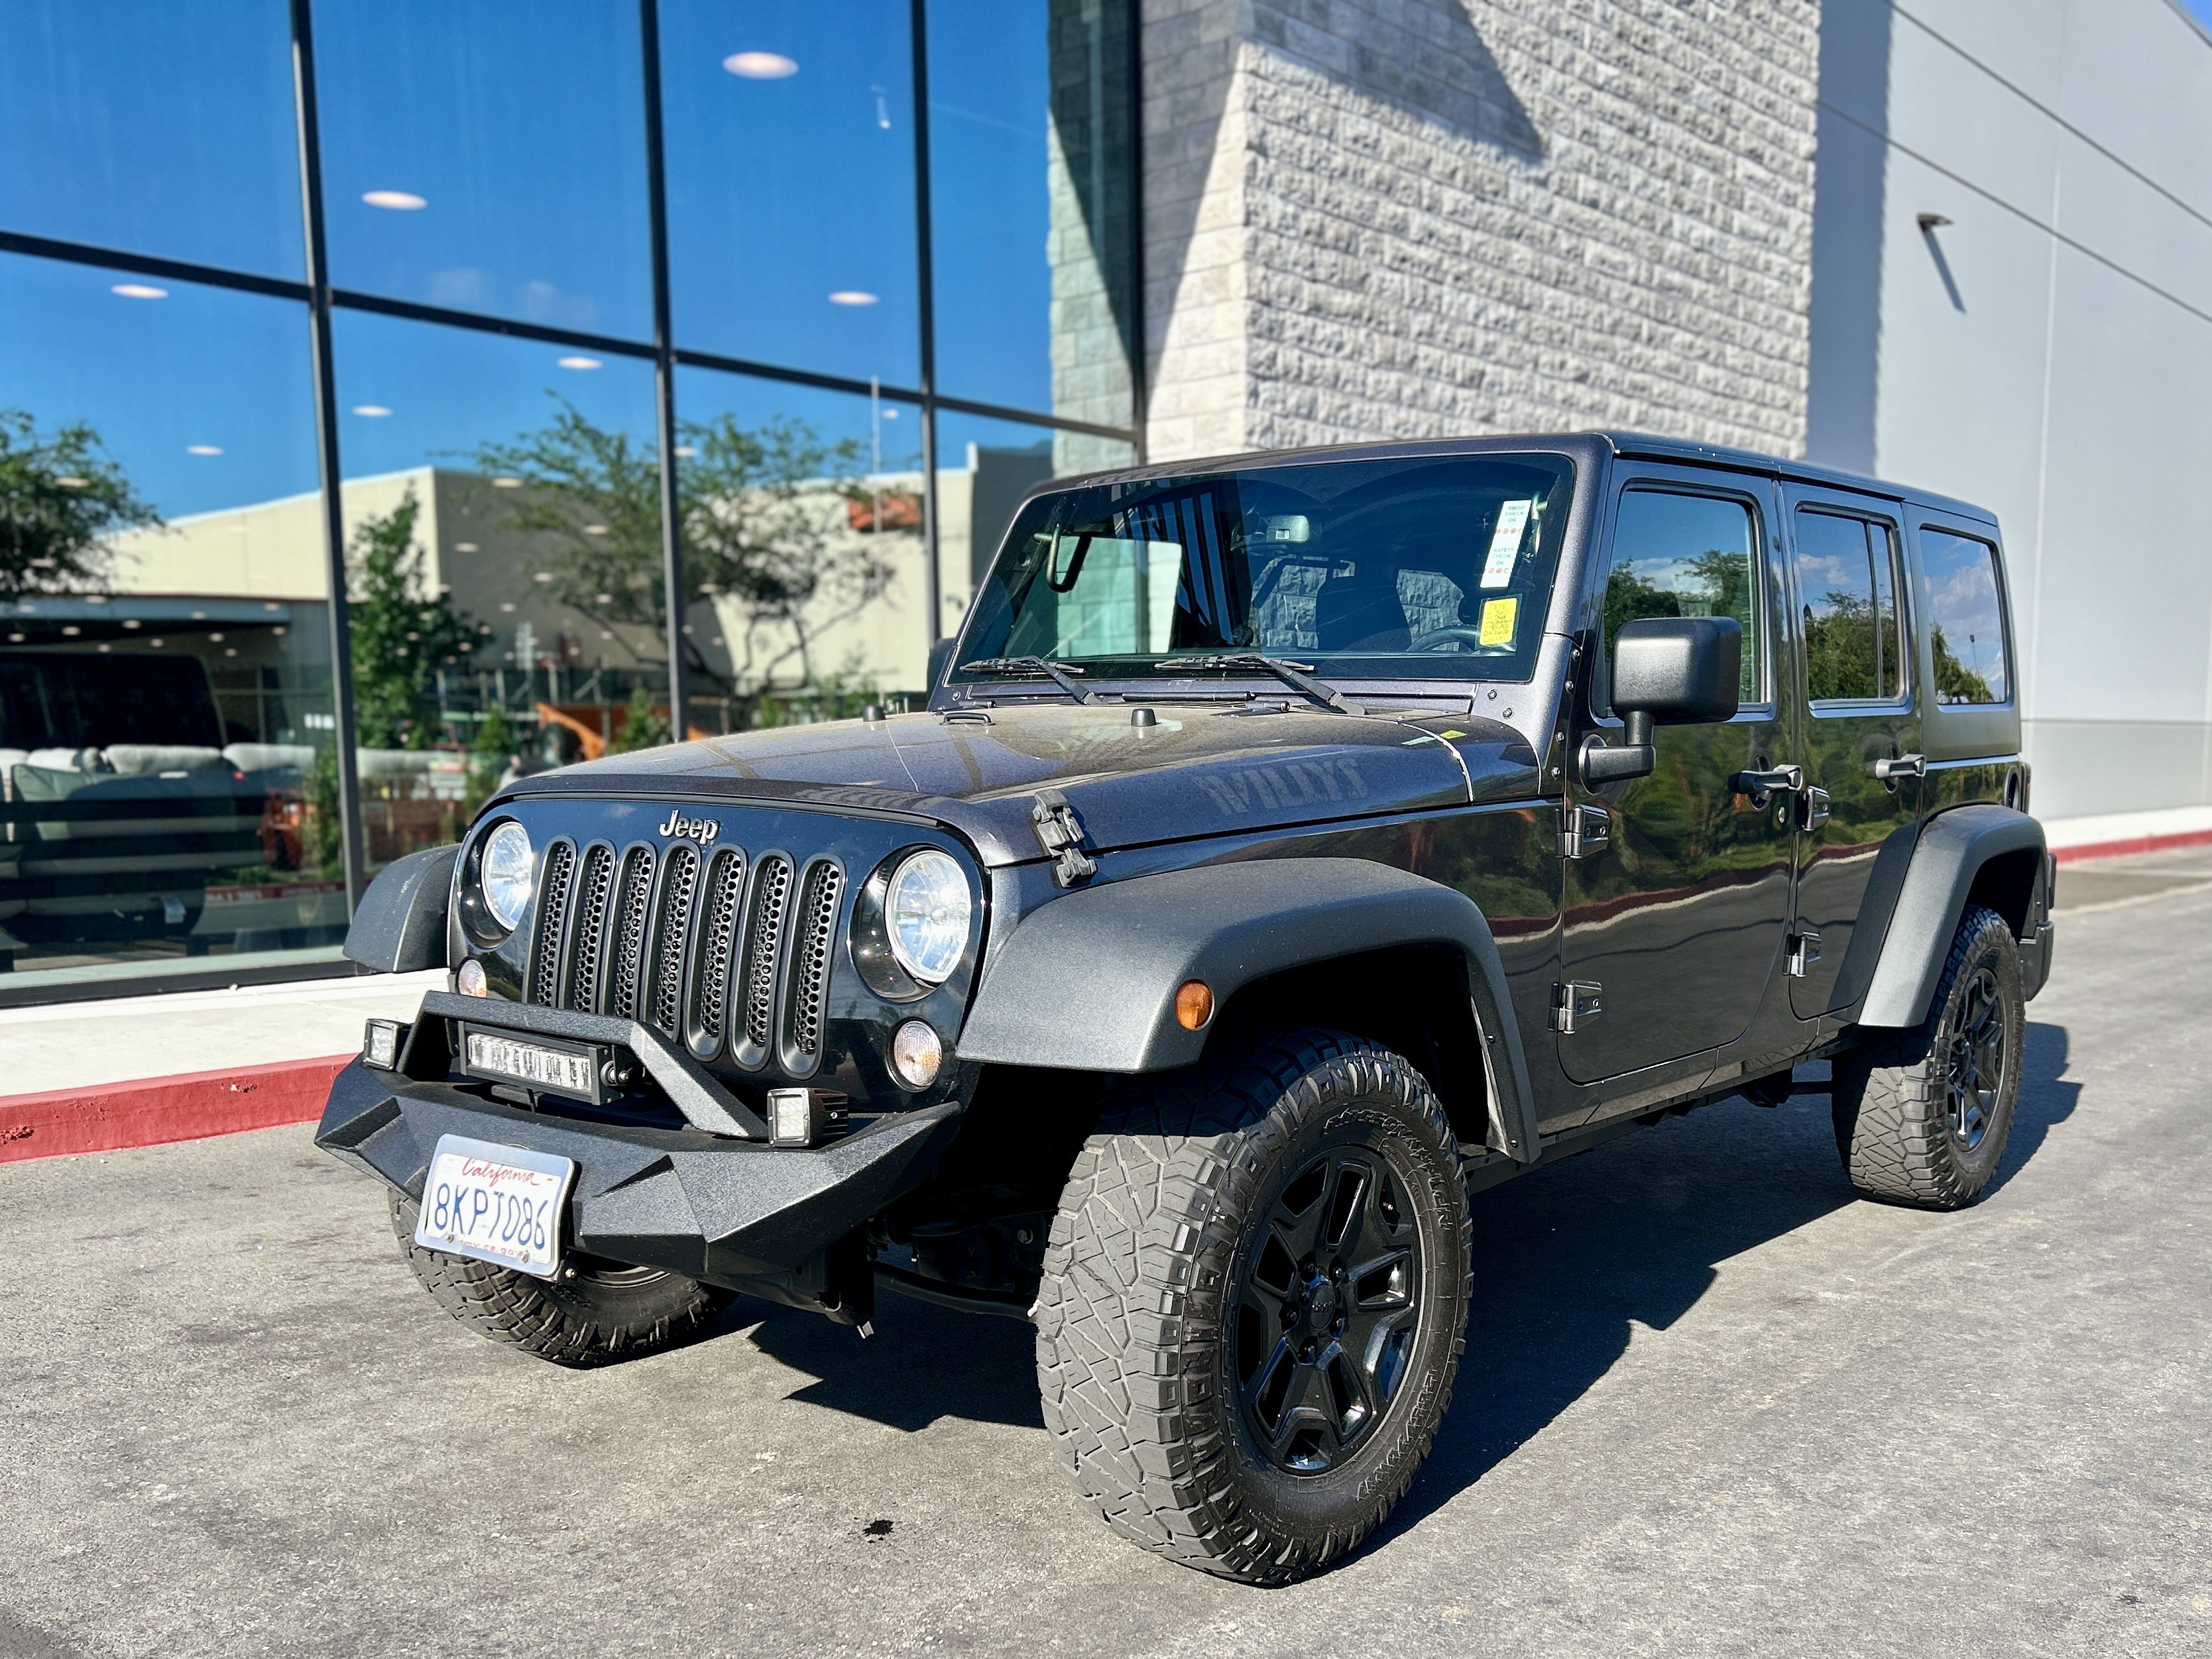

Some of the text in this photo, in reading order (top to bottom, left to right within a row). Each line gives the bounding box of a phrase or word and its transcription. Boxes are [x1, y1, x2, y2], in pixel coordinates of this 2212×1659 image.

[1194, 758, 1368, 817] WILLYS
[658, 809, 721, 845] Jeep
[461, 1156, 541, 1188] California
